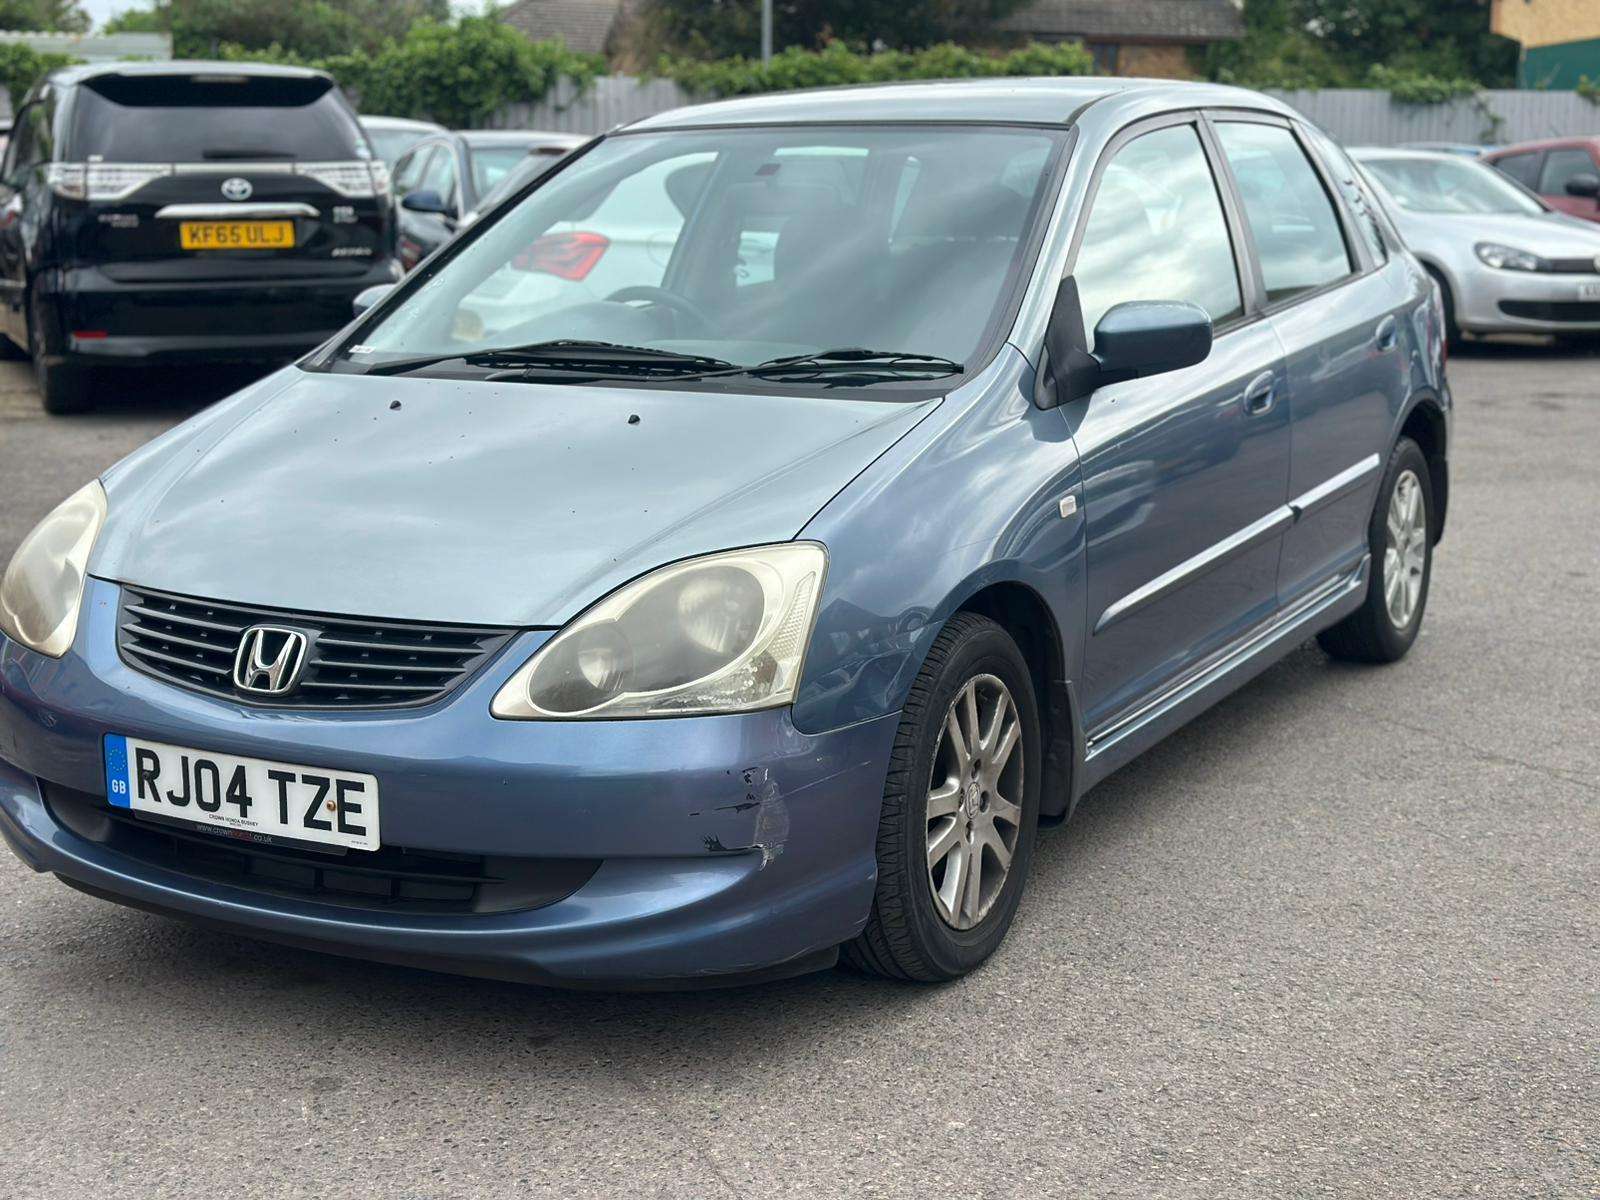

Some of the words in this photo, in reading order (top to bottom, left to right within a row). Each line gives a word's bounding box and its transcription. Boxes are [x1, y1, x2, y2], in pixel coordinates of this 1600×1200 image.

[188, 222, 241, 244] KF65
[245, 222, 284, 244] ULJ
[111, 779, 127, 795] GB
[135, 747, 253, 818] RJ04
[267, 769, 367, 837] TZE
